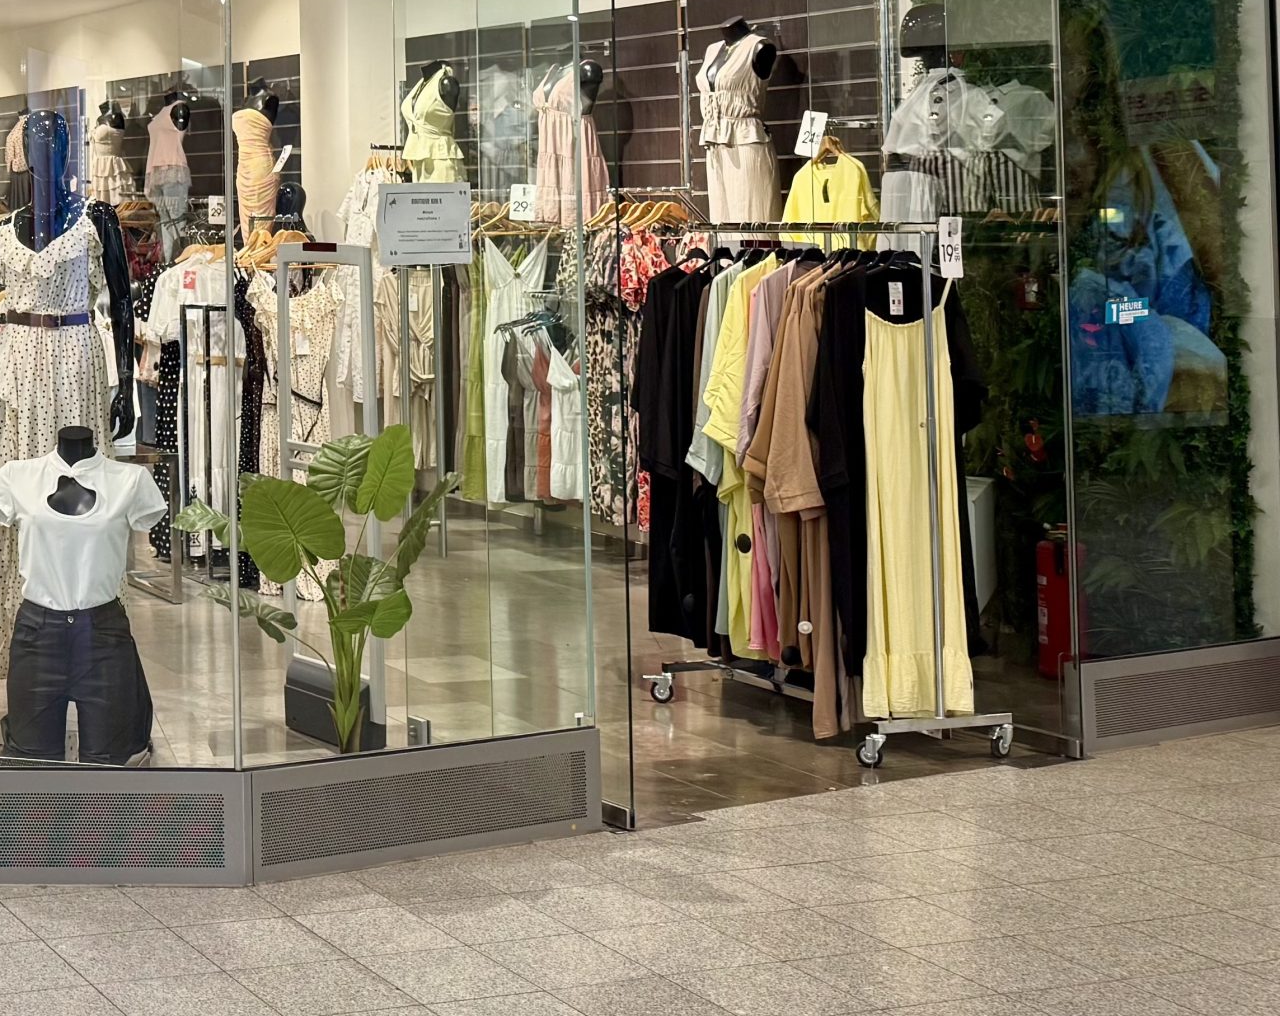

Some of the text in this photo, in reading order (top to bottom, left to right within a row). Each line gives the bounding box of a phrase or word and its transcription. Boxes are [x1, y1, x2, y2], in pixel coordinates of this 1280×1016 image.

[512, 201, 529, 212] 29
[941, 244, 954, 263] 19
[1112, 303, 1118, 322] 1
[1120, 301, 1142, 311] HEURE
